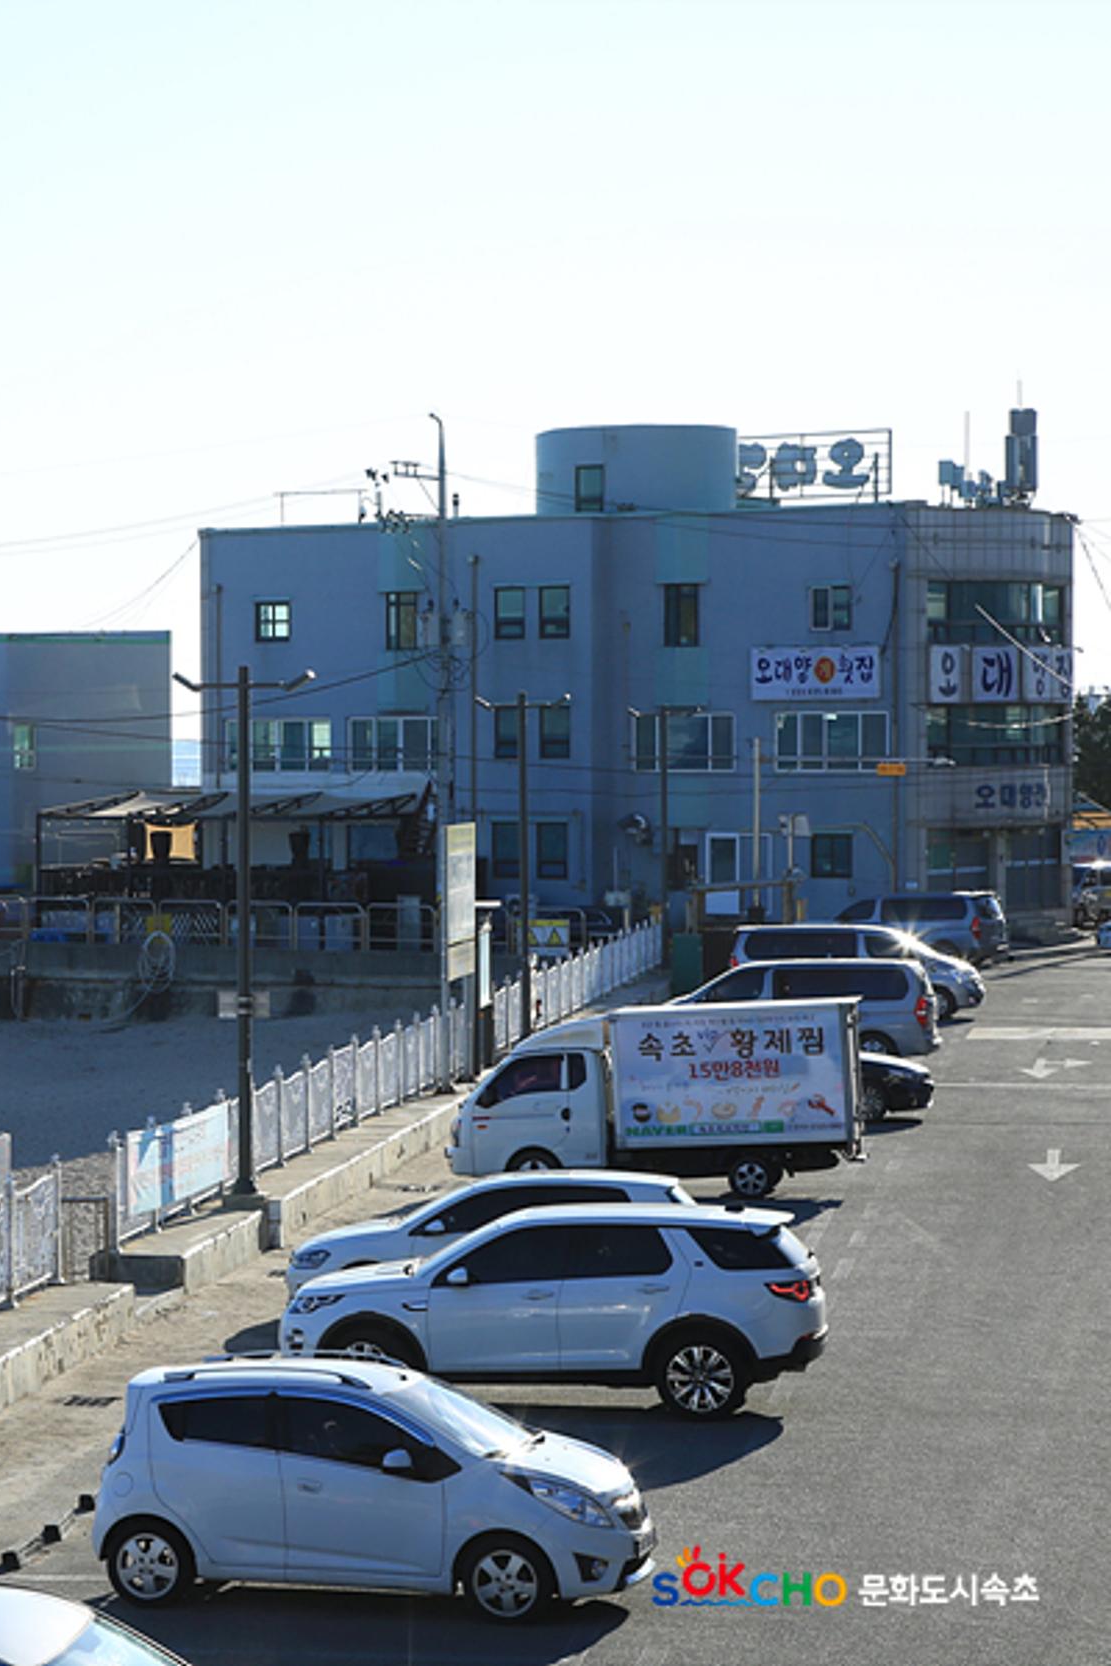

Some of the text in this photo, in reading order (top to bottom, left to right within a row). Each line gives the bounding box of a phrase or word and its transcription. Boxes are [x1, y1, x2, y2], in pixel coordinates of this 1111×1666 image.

[755, 654, 874, 684] 오대양 횟집
[638, 1030, 697, 1062] 속초
[729, 1026, 826, 1059] 황제찜
[688, 1058, 782, 1081] 15만8천원
